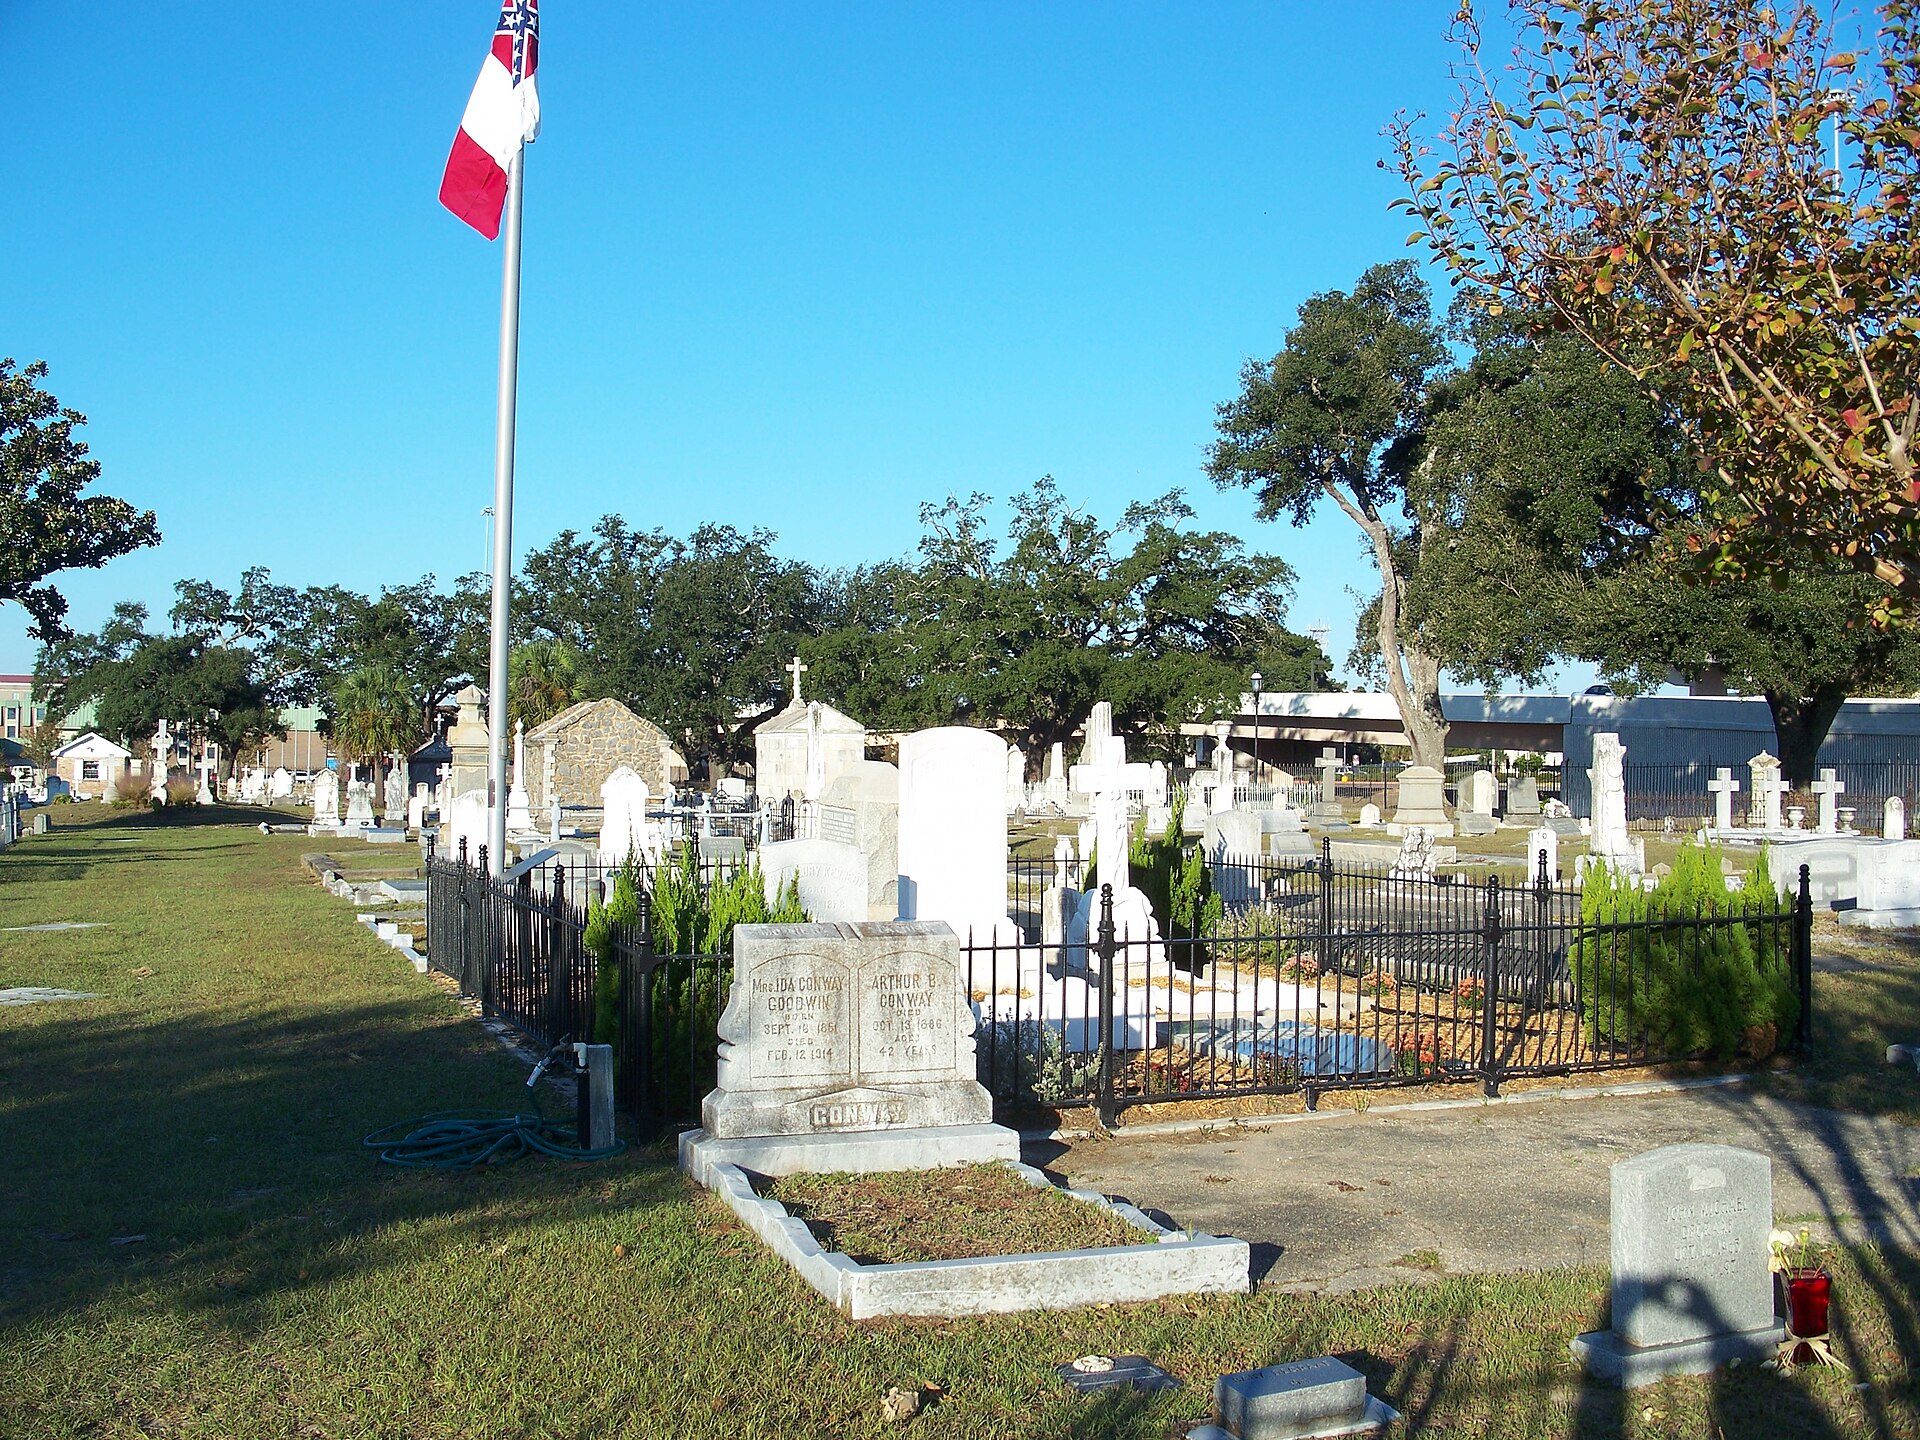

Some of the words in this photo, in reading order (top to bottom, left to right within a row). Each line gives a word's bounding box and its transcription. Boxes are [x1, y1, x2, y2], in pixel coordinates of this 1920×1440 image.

[798, 975, 846, 992] CONWAY
[871, 973, 921, 990] ARTHUR
[767, 994, 831, 1011] GOODWIN
[880, 991, 934, 1008] CONWAY
[783, 1012, 815, 1021] BORN
[896, 1008, 921, 1017] DIED
[763, 1022, 794, 1035] SEPT.
[787, 1037, 814, 1046] DIED
[767, 1049, 792, 1061] FEB.
[795, 1049, 807, 1060] 12
[879, 1046, 894, 1057] 42
[813, 1101, 906, 1125] CONWAY
